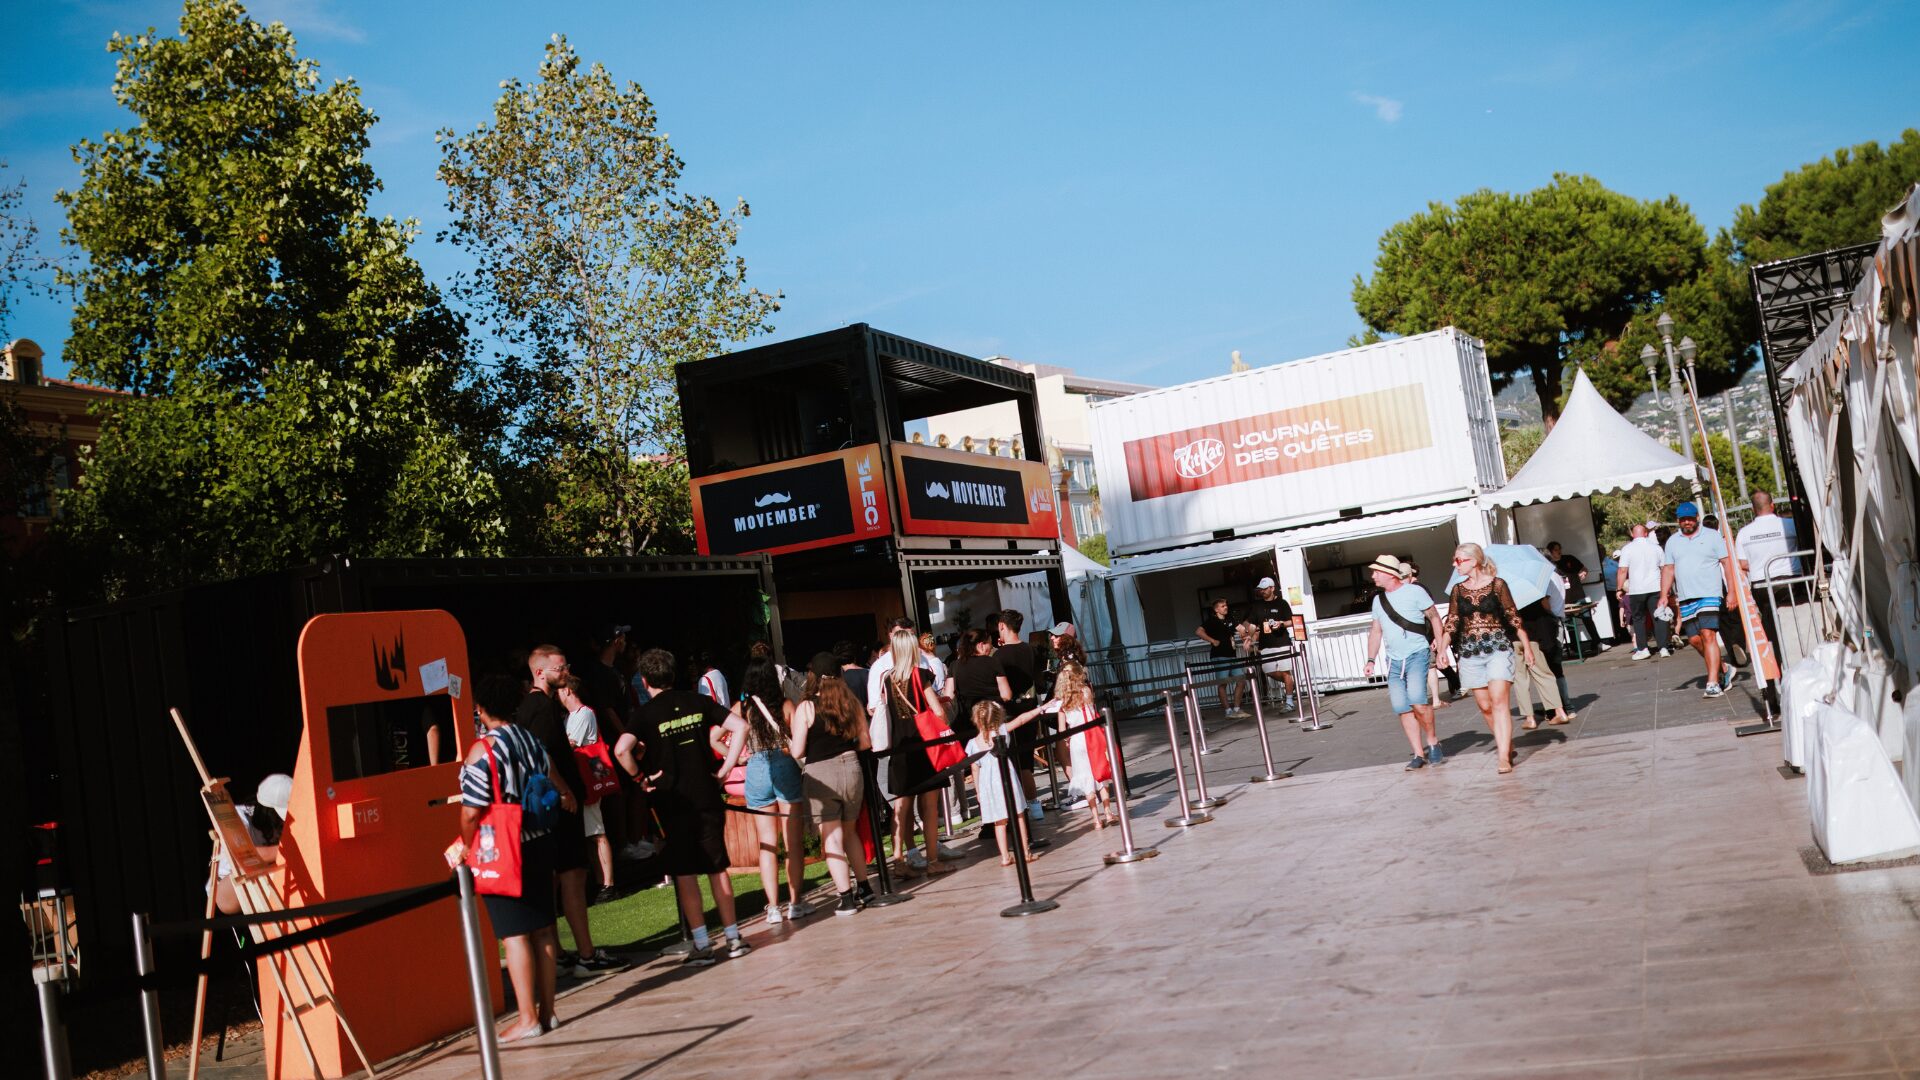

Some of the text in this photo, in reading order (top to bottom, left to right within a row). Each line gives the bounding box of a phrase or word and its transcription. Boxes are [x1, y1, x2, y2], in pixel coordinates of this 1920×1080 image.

[1232, 418, 1339, 449] JOURNAL
[1235, 428, 1374, 467] DES QUÊTES
[1178, 440, 1223, 477] KitKat
[951, 480, 1006, 507] MOVEMBER
[734, 504, 817, 532] MOVEMBER
[355, 807, 380, 824] TIPS
